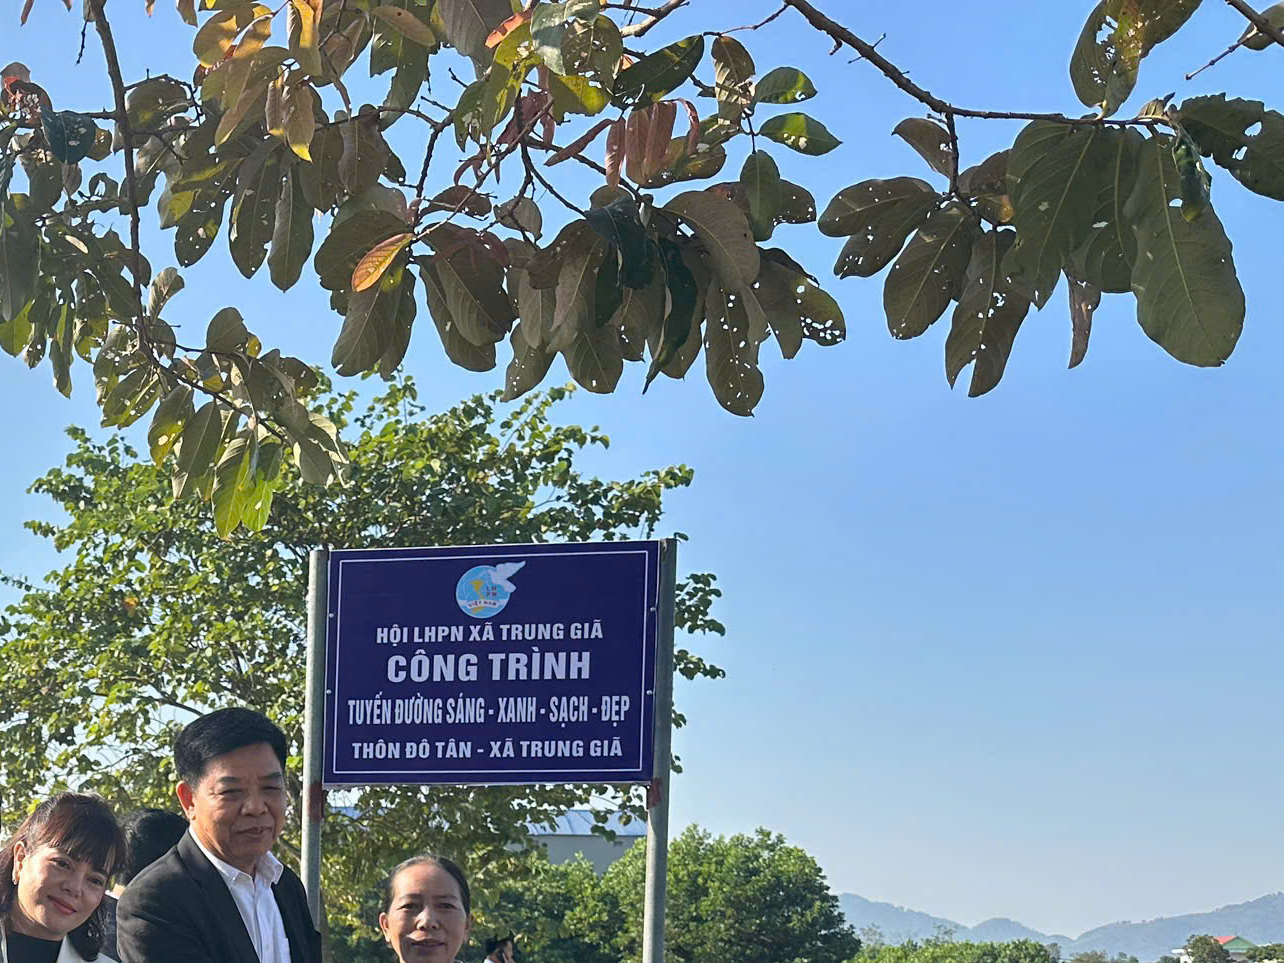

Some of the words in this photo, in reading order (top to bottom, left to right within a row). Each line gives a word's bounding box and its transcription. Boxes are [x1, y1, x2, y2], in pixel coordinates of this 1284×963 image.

[377, 624, 408, 646] HỘI
[414, 626, 463, 642] LHPN
[469, 622, 494, 641] XÃ
[500, 624, 564, 640] TRUNG
[571, 620, 602, 639] GIÃ
[388, 649, 477, 682] CÔNG
[489, 647, 590, 680] TRÌNH
[348, 692, 391, 724] TUYẾN
[395, 693, 442, 724] ĐƯỜNG
[446, 693, 484, 723] SÁNG
[498, 697, 536, 722] XANH
[550, 696, 588, 727] SẠCH
[601, 696, 629, 726] ĐẸP
[352, 739, 400, 758] THÔN
[405, 739, 429, 758] ĐÔ
[435, 739, 471, 758] TÂN
[490, 738, 514, 757] XÃ
[520, 741, 583, 757] TRUNG
[590, 737, 622, 756] GIÃ
